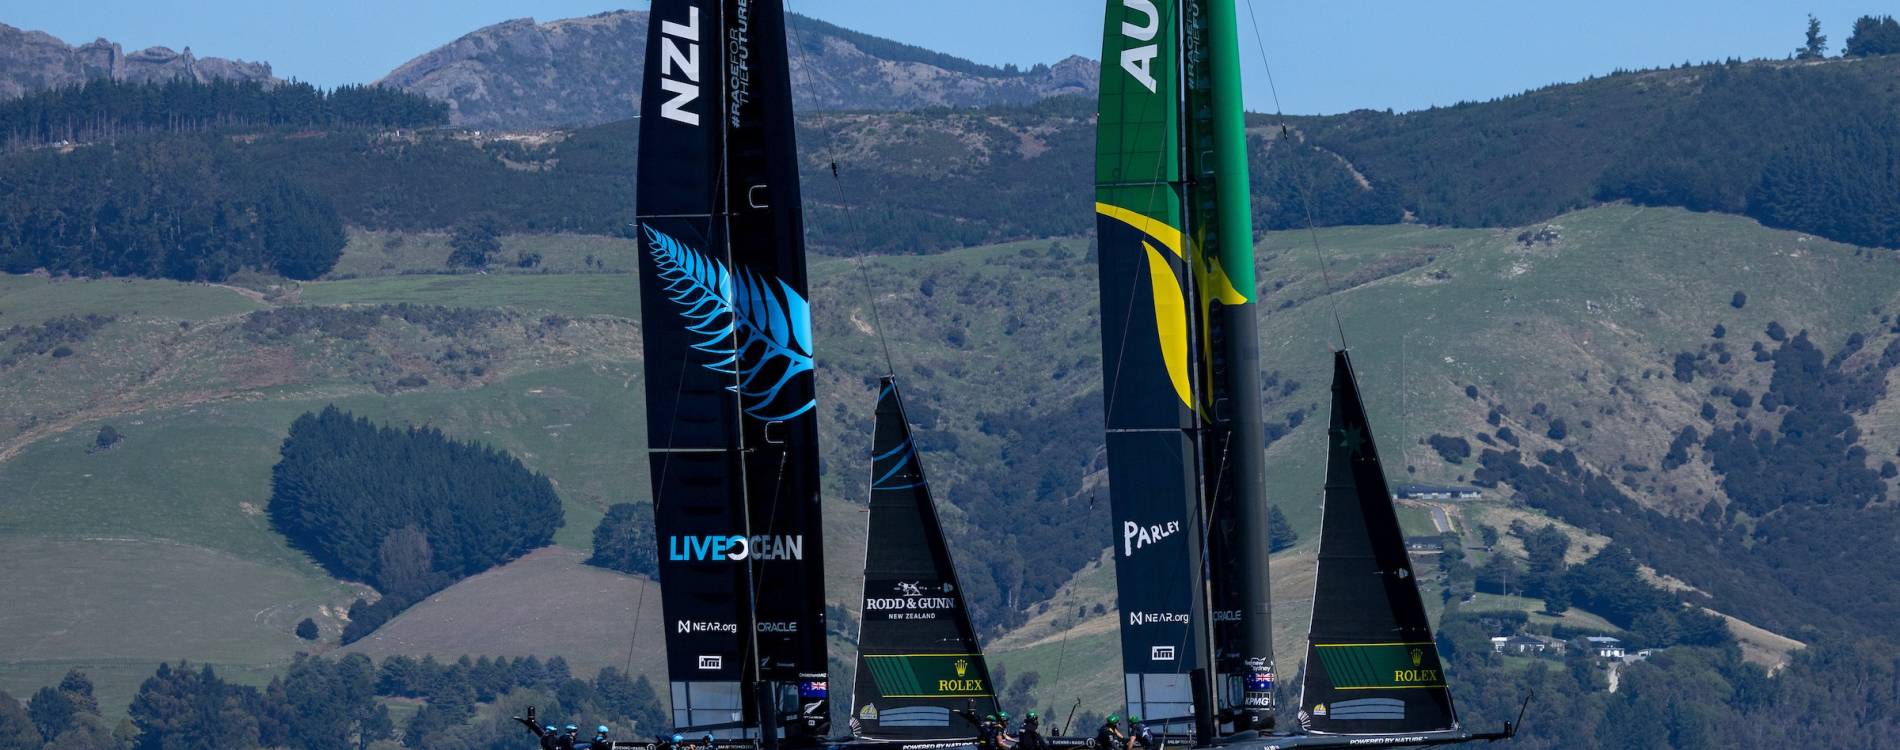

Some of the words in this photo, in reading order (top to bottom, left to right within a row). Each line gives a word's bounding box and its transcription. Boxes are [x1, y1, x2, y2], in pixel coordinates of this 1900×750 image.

[1120, 0, 1159, 94] AU
[660, 5, 700, 127] NZL
[729, 26, 741, 129] #RACEFOR
[866, 598, 905, 610] RODD
[907, 598, 918, 610] &
[918, 597, 955, 609] GUNN
[1145, 612, 1189, 624] NEAR.org
[1212, 609, 1243, 621] ORACLE
[693, 622, 737, 634] NEAR.org
[757, 621, 798, 632] ORACLE
[1394, 669, 1438, 682] ROLEX
[938, 679, 983, 692] ROLEX
[1245, 697, 1268, 706] KPMG
